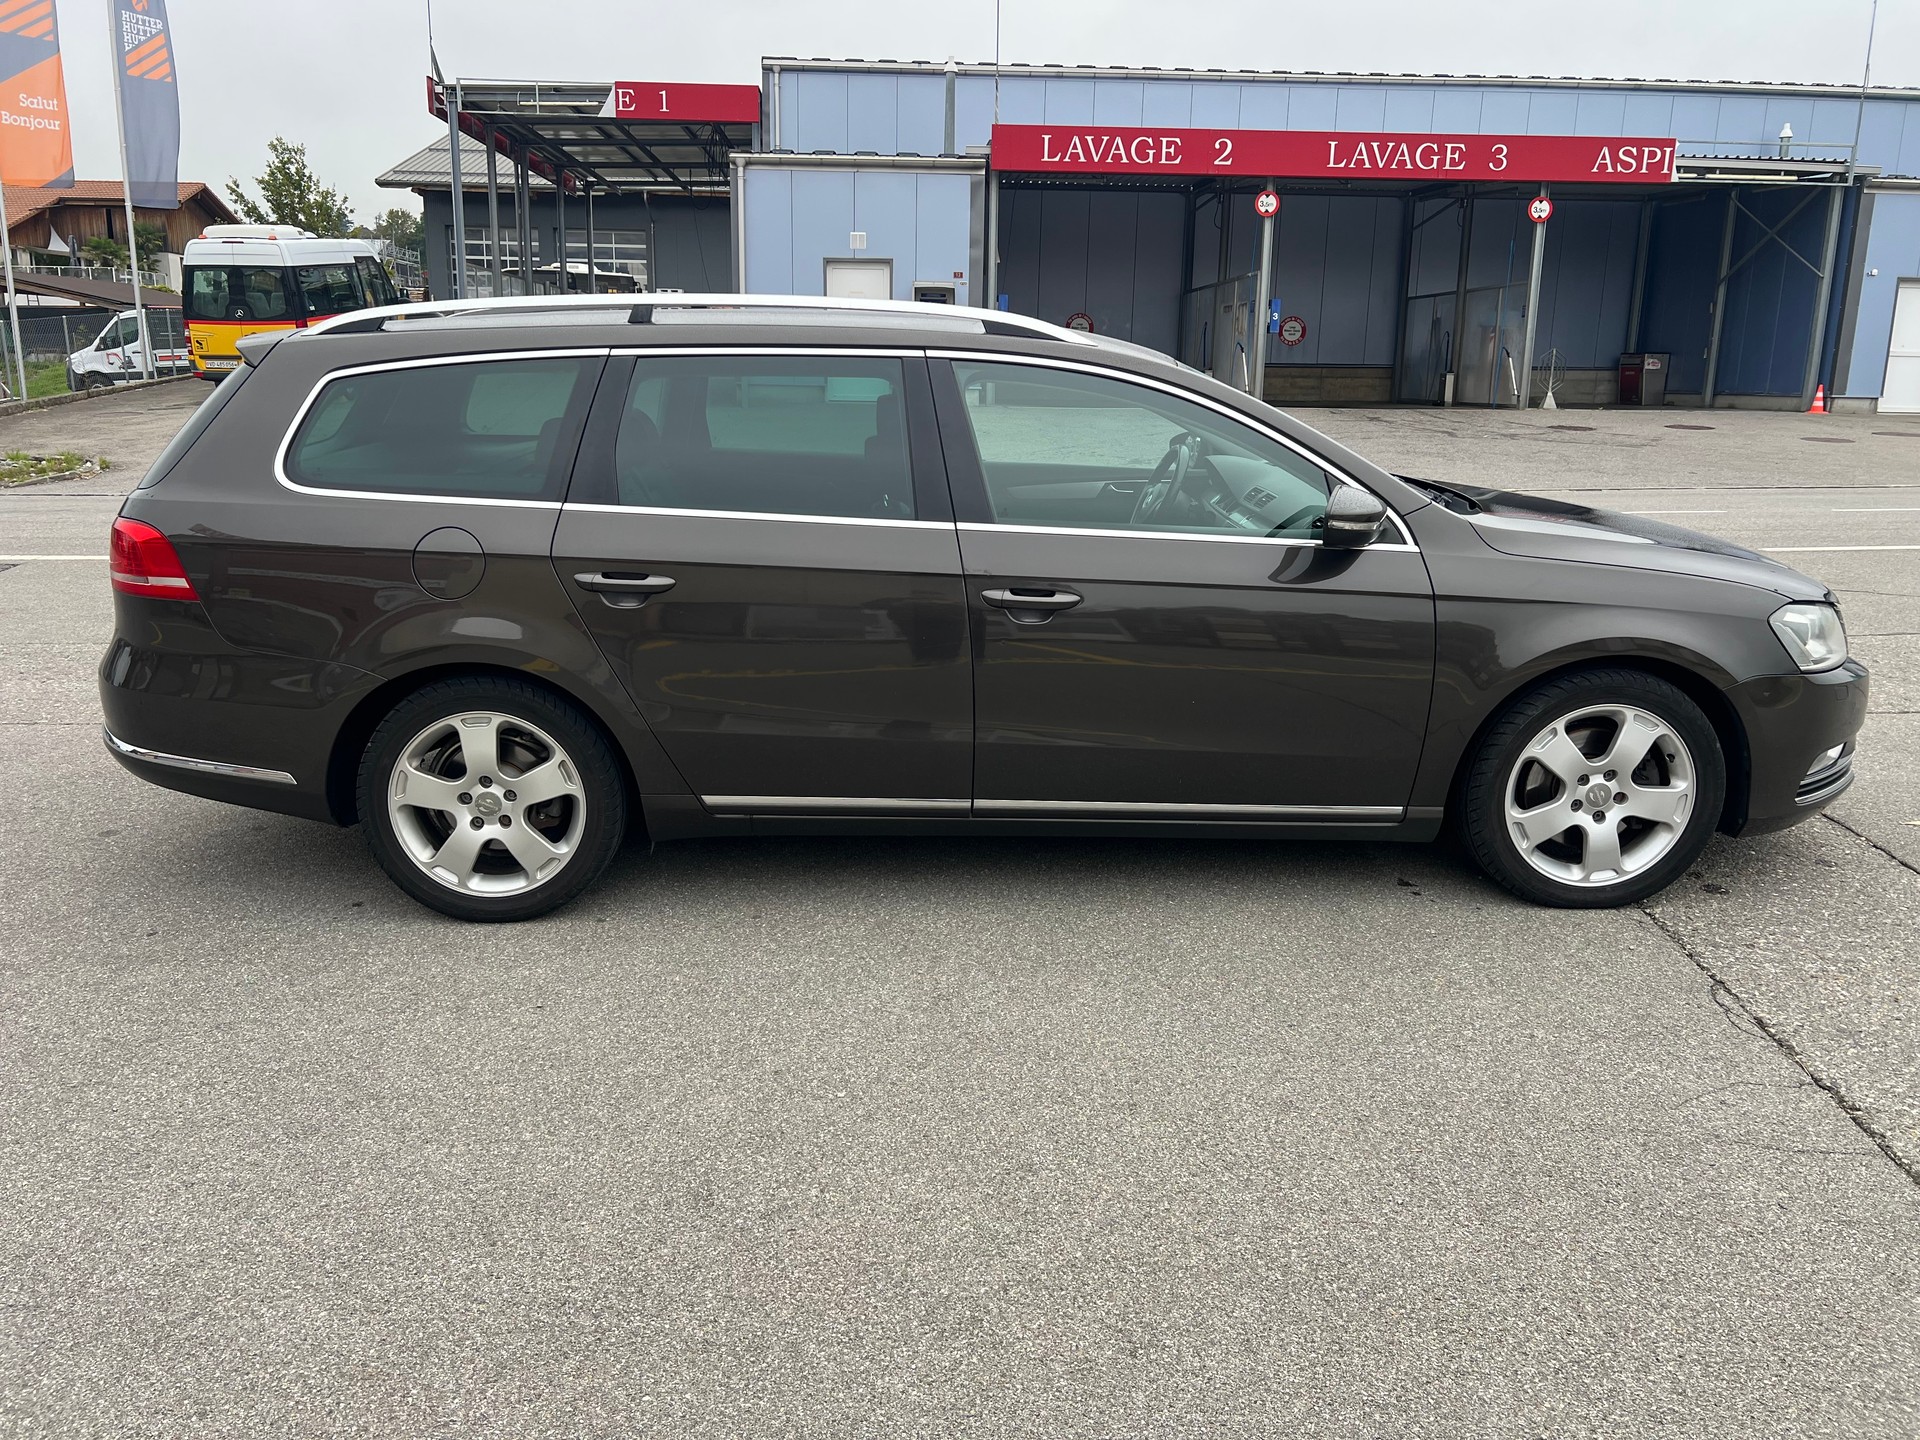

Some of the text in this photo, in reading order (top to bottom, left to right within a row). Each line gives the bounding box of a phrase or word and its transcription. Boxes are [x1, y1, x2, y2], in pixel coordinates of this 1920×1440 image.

[121, 10, 163, 30] HUTTER
[19, 93, 59, 111] Salut
[616, 88, 670, 112] E 1
[0, 111, 61, 130] Bonjour
[1040, 134, 1233, 166] LAVAGE 2
[1326, 140, 1509, 172] LAVAGE 3
[1590, 146, 1674, 174] ASPI
[1272, 312, 1279, 320] 3
